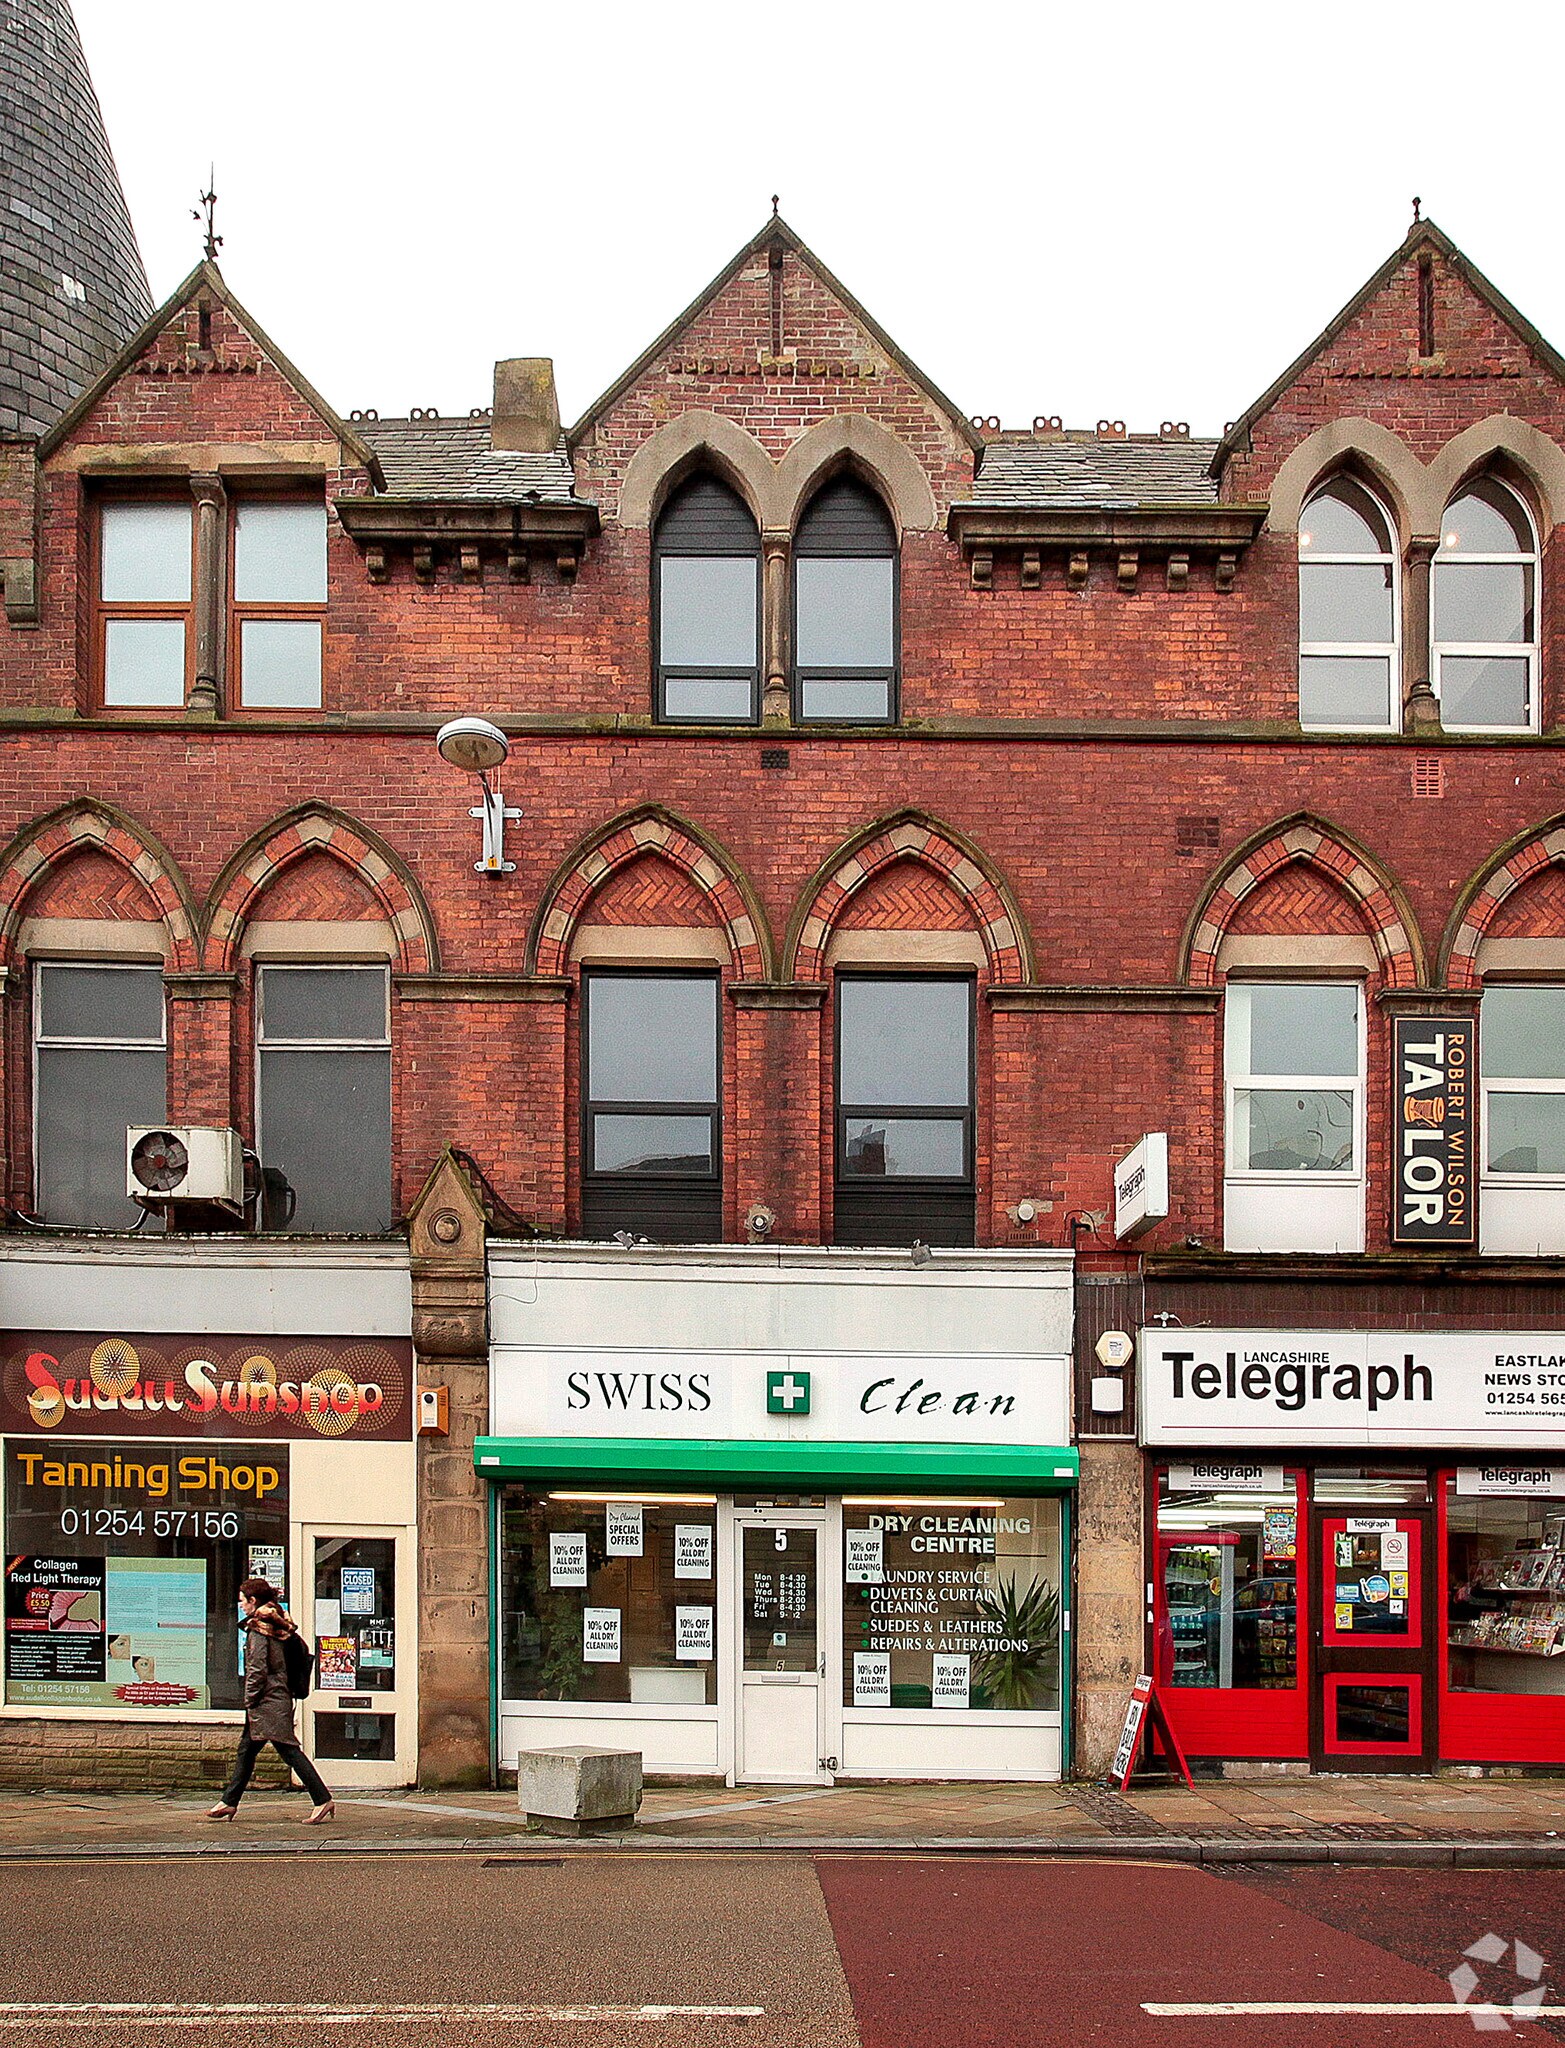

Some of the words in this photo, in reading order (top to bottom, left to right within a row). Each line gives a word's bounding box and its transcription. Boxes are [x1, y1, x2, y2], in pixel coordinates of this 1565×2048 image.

[1448, 1034, 1464, 1120] ROBERT
[1448, 1130, 1464, 1225] WILSON
[1244, 1351, 1330, 1364] LANCASHIRE
[1162, 1352, 1433, 1411] Telegraph
[1484, 1374, 1532, 1386] NEWS
[184, 1360, 384, 1414] Sunshop
[567, 1371, 712, 1412] SWISS
[860, 1377, 1016, 1415] Clean
[1487, 1392, 1536, 1404] 01254
[17, 1453, 169, 1497] Tanning
[178, 1456, 279, 1498] Shop
[1192, 1466, 1262, 1480] Telegraph
[1478, 1468, 1551, 1485] Telegraph
[60, 1508, 146, 1536] 01254
[154, 1511, 238, 1538] 57156
[868, 1515, 912, 1532] DRY
[920, 1516, 1031, 1534] CLEANING
[1354, 1520, 1390, 1528] Telegraph
[610, 1525, 640, 1534] SPECIAL
[610, 1536, 639, 1545] OFFERS
[678, 1538, 693, 1547] 10%
[695, 1538, 708, 1547] OFF
[775, 1529, 788, 1551] 5
[910, 1536, 995, 1554] CENTRE
[252, 1547, 282, 1556] FISKY'S
[554, 1546, 568, 1555] 10%
[570, 1546, 583, 1555] OFF
[681, 1549, 692, 1557] ALL
[693, 1549, 705, 1557] DRY
[850, 1542, 864, 1552] 10%
[866, 1542, 880, 1552] OFF
[34, 1559, 78, 1571] Collagen
[677, 1559, 709, 1567] CLEANING
[848, 1563, 880, 1571] CLEANING
[11, 1573, 30, 1582] Red
[34, 1573, 58, 1584] Light
[61, 1574, 101, 1586] Therapy
[344, 1576, 372, 1585] CLOSED
[938, 1570, 990, 1584] SERVICE
[870, 1588, 925, 1600] DUVETS
[927, 1588, 937, 1600] &
[939, 1588, 998, 1601] CURTAIN
[871, 1601, 939, 1614] CLEANING
[588, 1621, 602, 1630] 10%
[604, 1621, 618, 1631] OFF
[680, 1619, 694, 1628] 10%
[696, 1619, 710, 1628] OFF
[870, 1620, 919, 1632] SUEDES
[923, 1620, 933, 1632] &
[940, 1621, 1003, 1634] LEATHERS
[586, 1642, 618, 1650] CLEANING
[678, 1640, 711, 1648] CLEANING
[870, 1638, 922, 1650] REPAIRS
[926, 1638, 935, 1650] &
[938, 1638, 1029, 1652] ALTERATIONS
[776, 1660, 785, 1672] 5
[857, 1666, 872, 1675] 10%
[873, 1666, 887, 1675] OFF
[937, 1667, 951, 1676] 10%
[952, 1667, 966, 1676] OFF
[21, 1684, 36, 1692] Tel:
[38, 1685, 62, 1693] 01254
[856, 1686, 888, 1694] CLEANING
[935, 1687, 967, 1696] CLEANING
